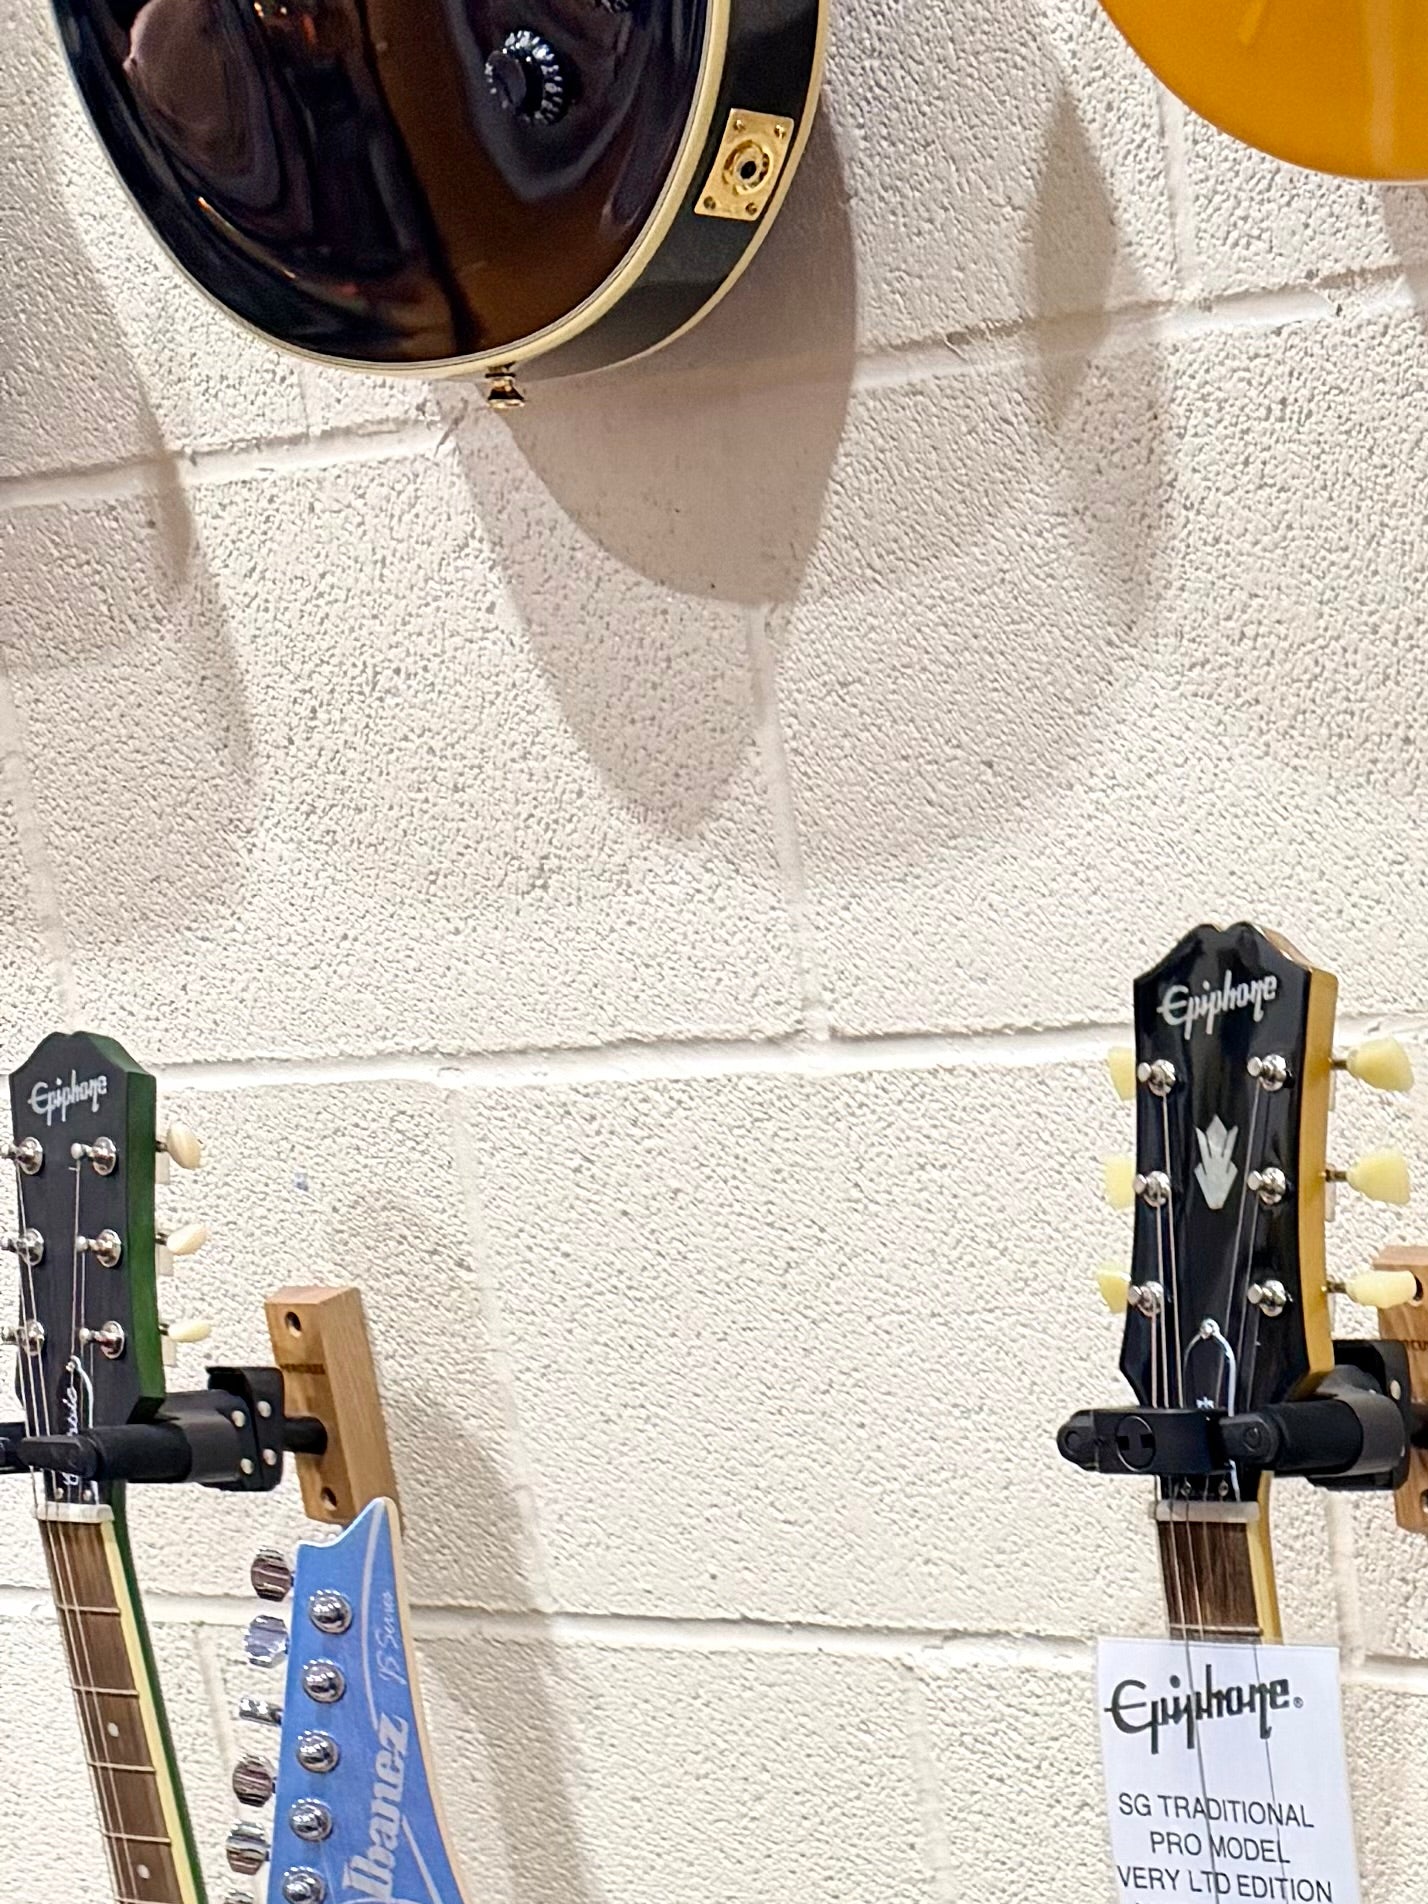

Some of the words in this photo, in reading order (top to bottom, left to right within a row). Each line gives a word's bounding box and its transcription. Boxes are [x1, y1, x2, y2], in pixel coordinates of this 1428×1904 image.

[1156, 970, 1277, 1039] Epiphone
[28, 1069, 109, 1127] Epiphone
[1104, 1663, 1290, 1755] Epiphone
[1118, 1792, 1151, 1818] SG
[1157, 1795, 1315, 1829] TRADITIONAL
[1150, 1831, 1202, 1857] PRO
[1208, 1834, 1291, 1865] MODEL
[1116, 1864, 1180, 1892] VERY
[1189, 1869, 1231, 1896] LTD
[1237, 1873, 1333, 1904] EDITION
